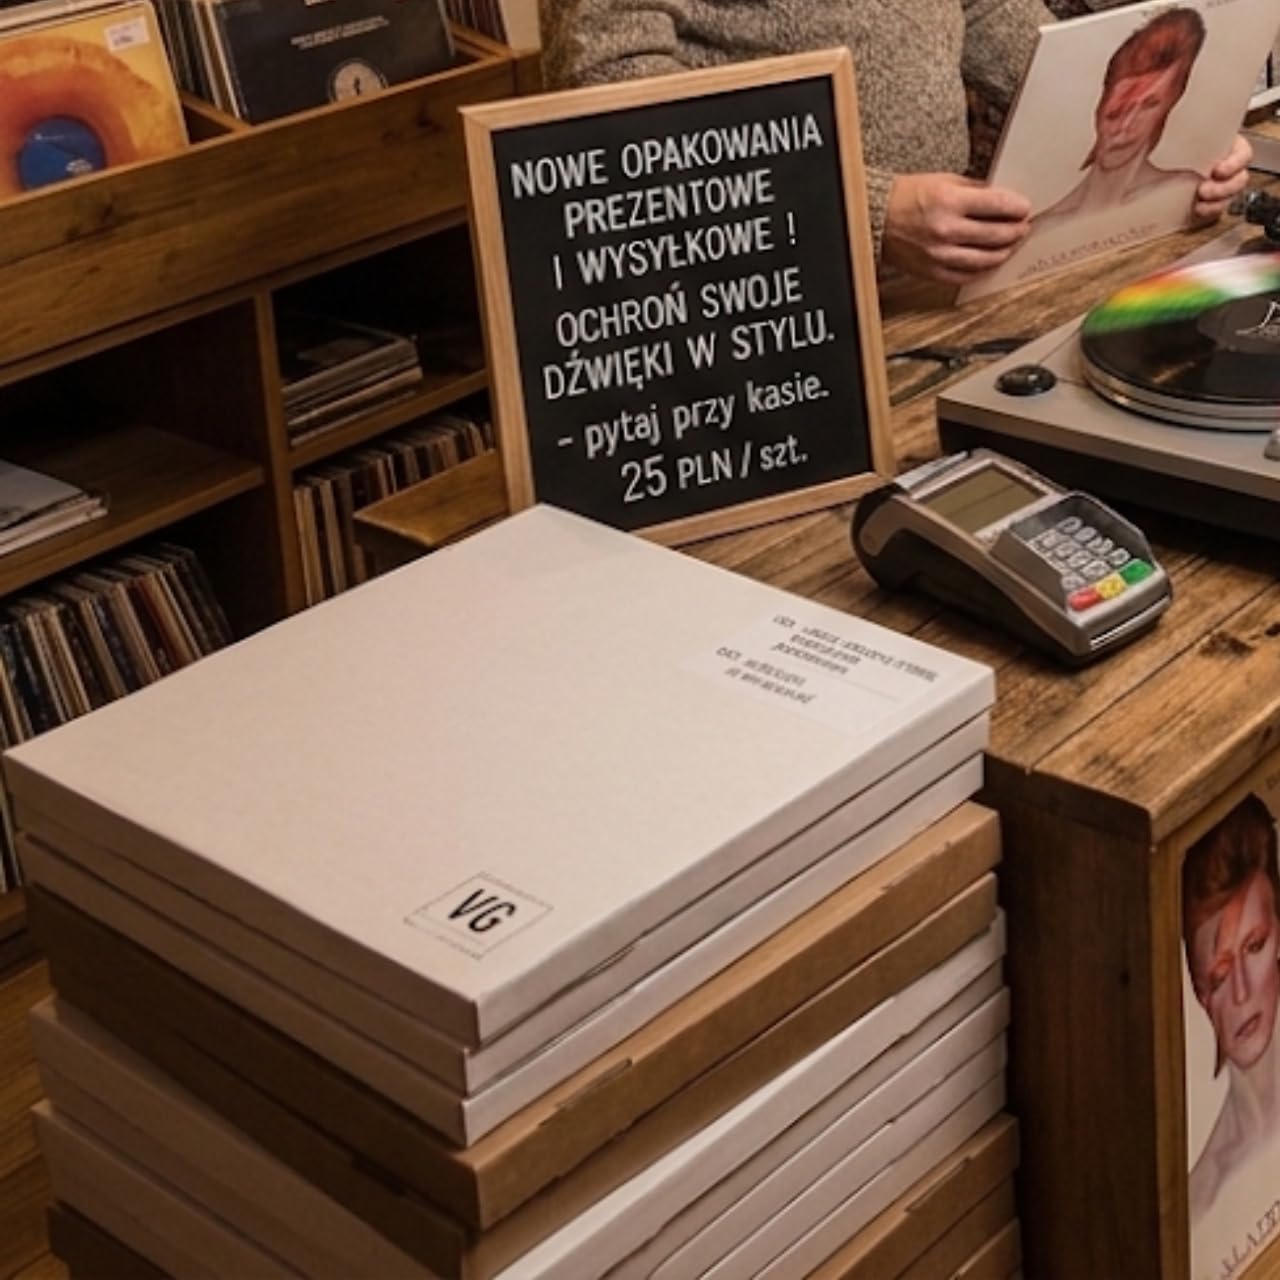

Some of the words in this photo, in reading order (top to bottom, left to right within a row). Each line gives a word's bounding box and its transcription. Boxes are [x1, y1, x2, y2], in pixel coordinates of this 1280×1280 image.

[510, 148, 609, 199] NOWE
[620, 113, 824, 179] OPAKOWANIA
[563, 168, 776, 239] PREZENTOWE
[552, 255, 564, 290] I
[576, 216, 775, 284] WYSYŁKOWE
[556, 281, 688, 348] OCHROŃ
[700, 267, 803, 319] SWOJE
[542, 341, 674, 400] DŹWIĘKI
[686, 333, 717, 370] W
[731, 309, 836, 361] STYLU.
[584, 404, 661, 459] pytaj
[673, 394, 735, 439] przy
[746, 372, 830, 413] kasie.
[620, 454, 668, 503] 25
[677, 448, 734, 490] PLN
[760, 434, 808, 471] szt.
[448, 888, 516, 933] VG
